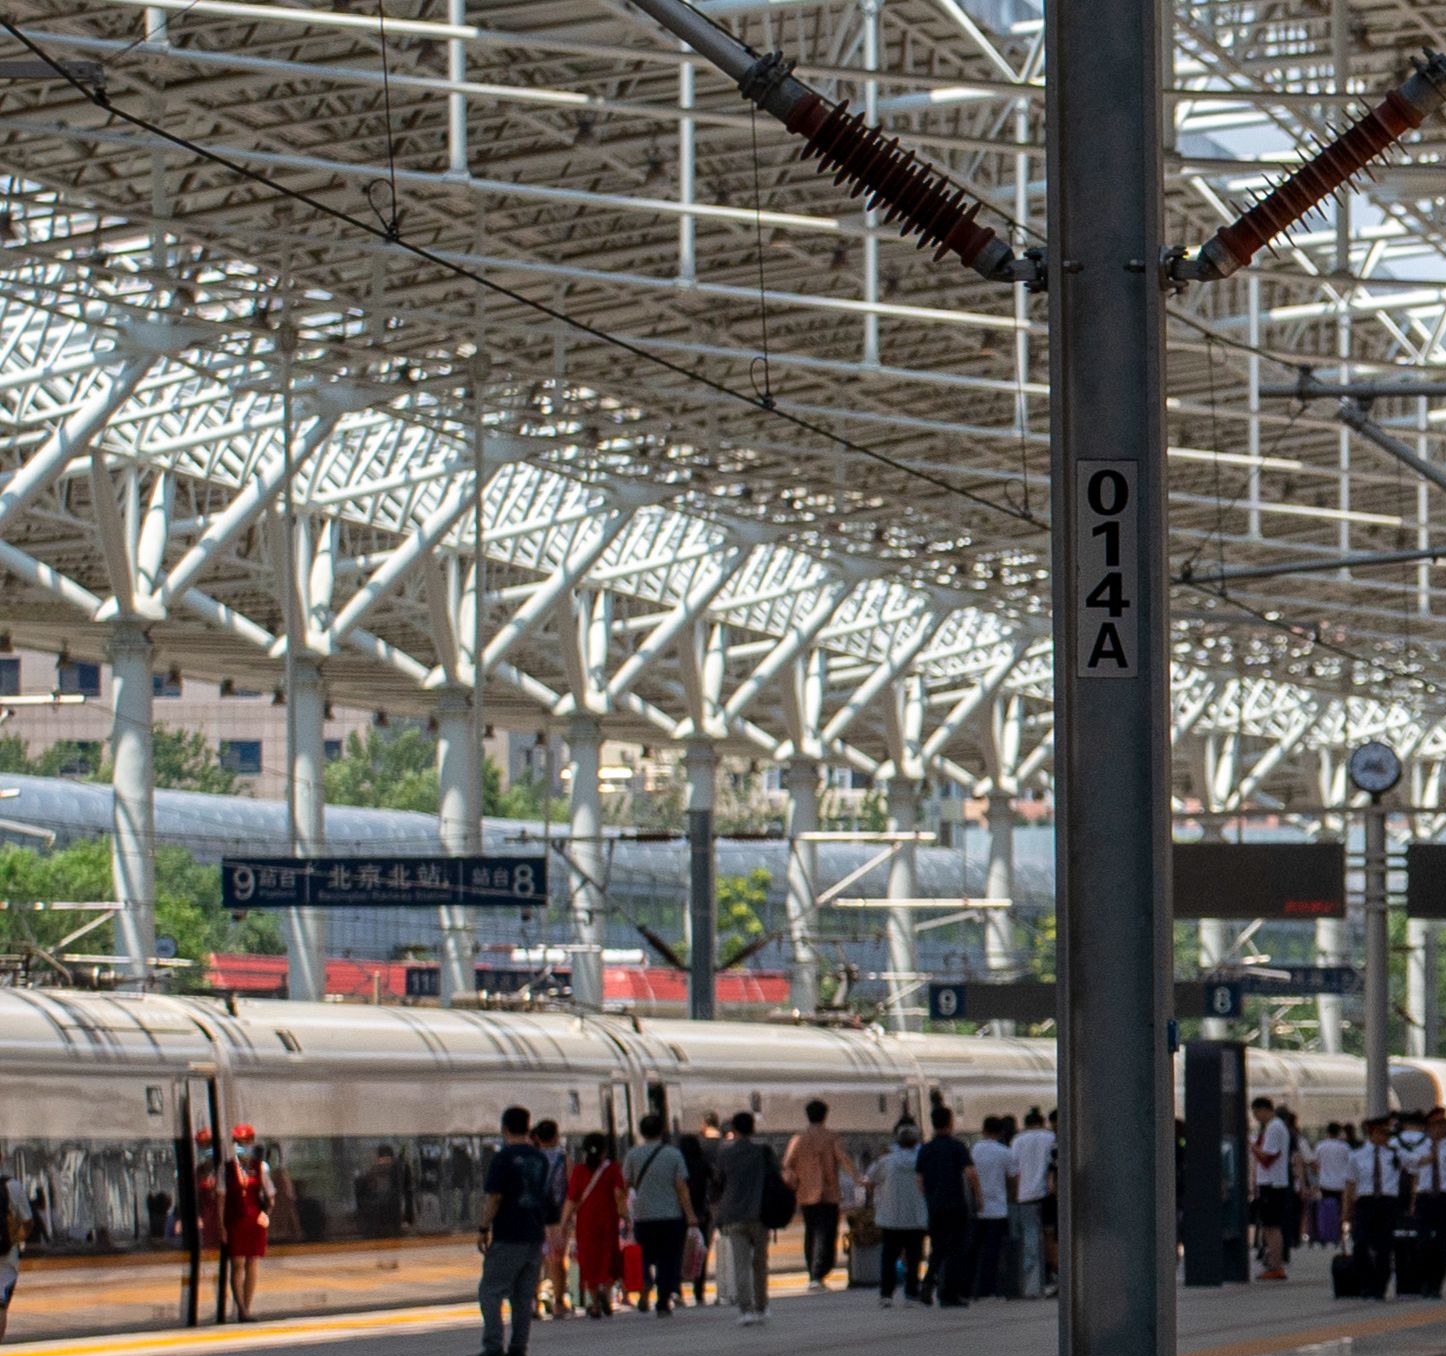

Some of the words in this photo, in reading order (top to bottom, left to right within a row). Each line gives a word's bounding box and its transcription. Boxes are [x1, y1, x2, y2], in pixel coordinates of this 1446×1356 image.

[1085, 469, 1130, 669] 014A
[232, 866, 256, 900] 9
[328, 862, 441, 890] 北京北站
[513, 864, 536, 898] 8
